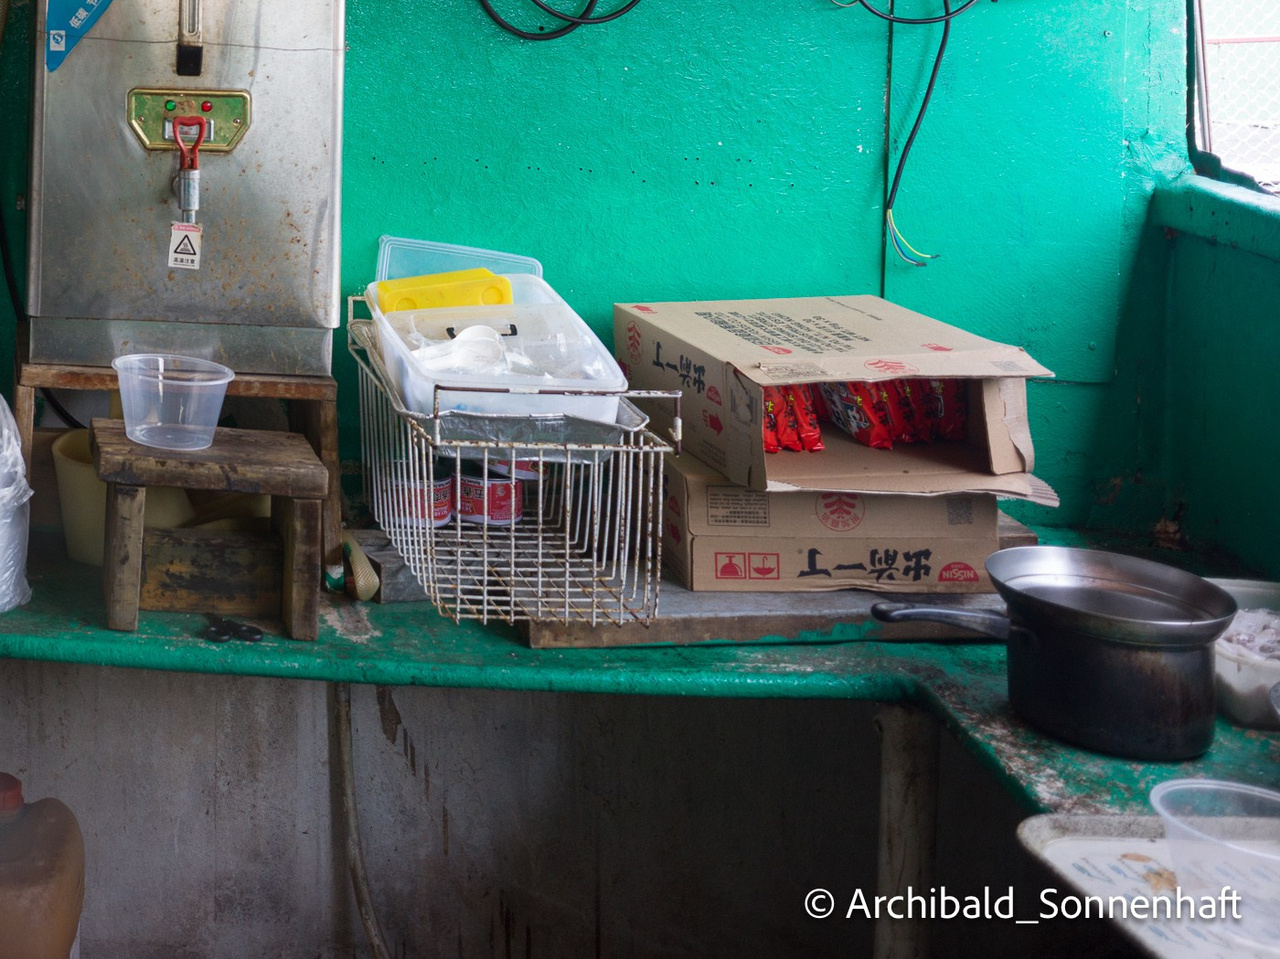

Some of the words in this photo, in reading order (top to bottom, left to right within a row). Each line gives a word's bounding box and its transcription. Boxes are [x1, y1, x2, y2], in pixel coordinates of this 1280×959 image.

[69, 7, 89, 29] 低碳
[797, 548, 932, 583] 出前一丁
[942, 568, 974, 581] NISSIN
